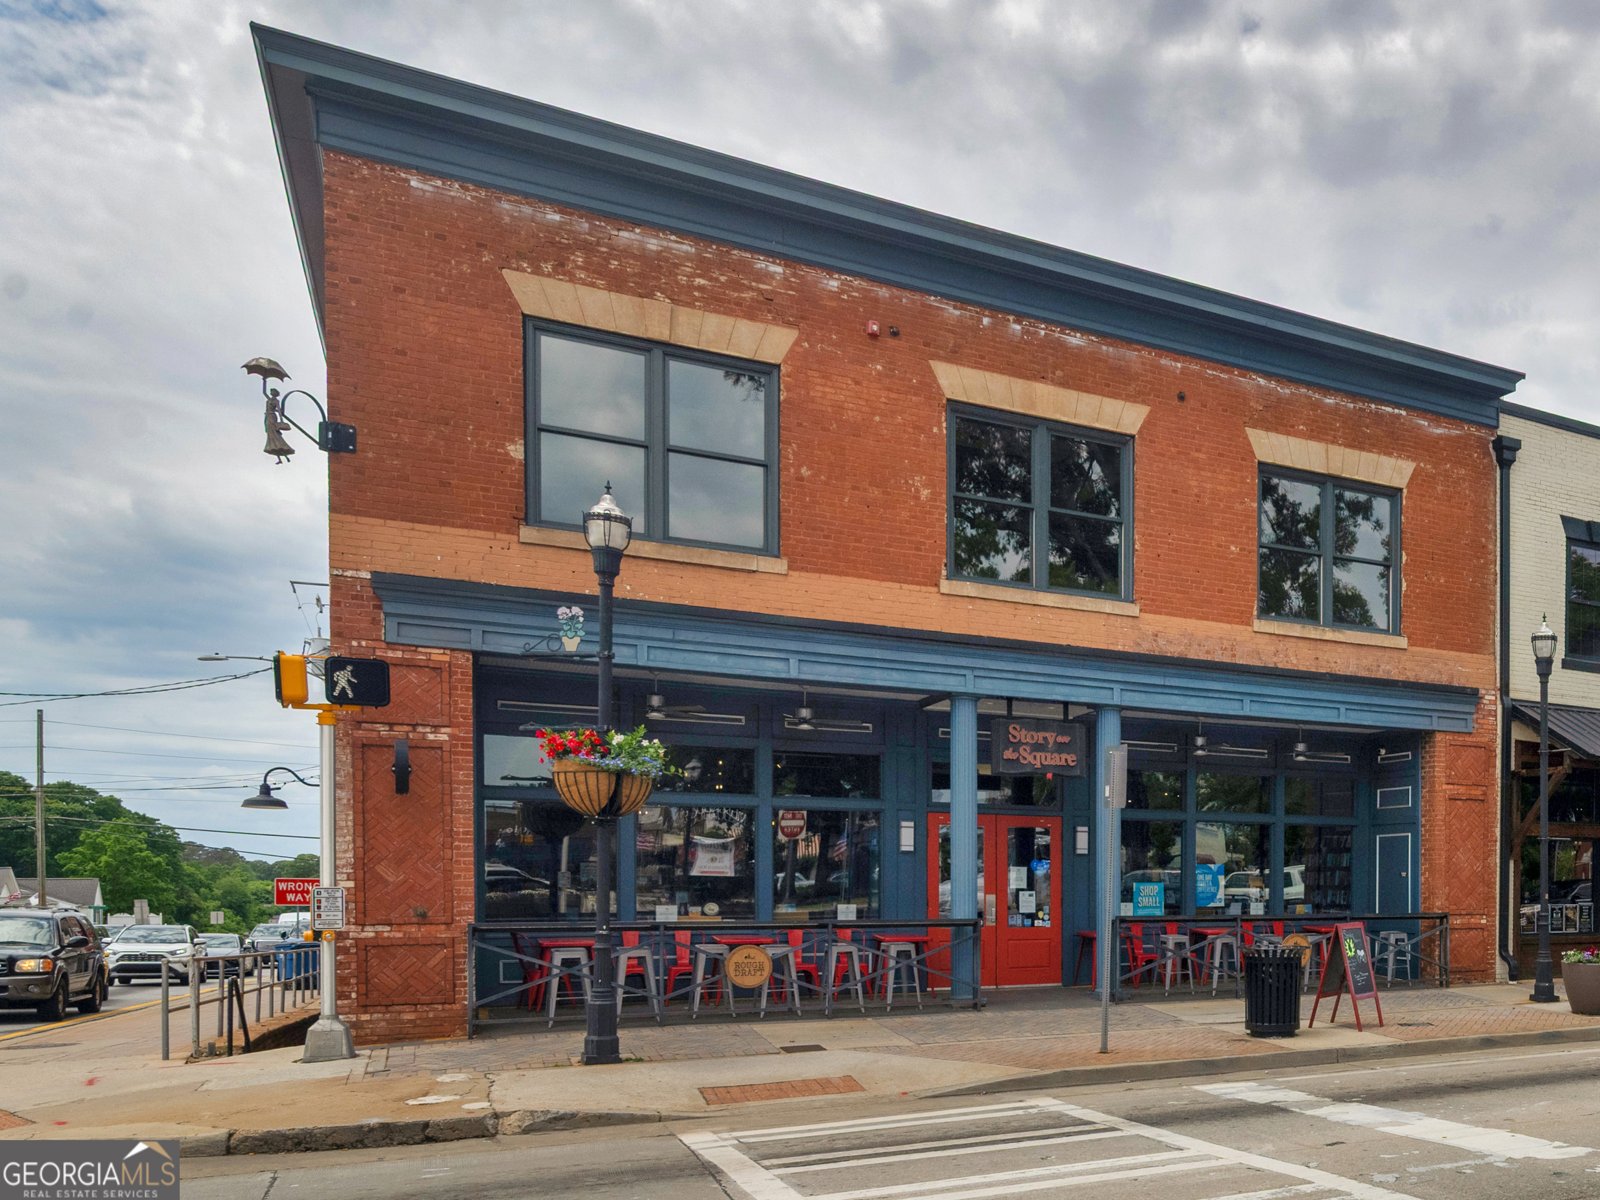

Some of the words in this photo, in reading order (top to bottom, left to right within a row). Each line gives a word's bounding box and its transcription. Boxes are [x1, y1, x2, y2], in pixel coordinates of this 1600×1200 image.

[1009, 723, 1056, 748] Story
[1019, 745, 1077, 768] Square
[278, 882, 320, 891] WRONG
[1139, 885, 1158, 896] SHOP
[286, 893, 310, 902] WAY
[1138, 896, 1160, 907] SMALL
[734, 961, 765, 969] ROUGH
[733, 968, 765, 977] DRAFT
